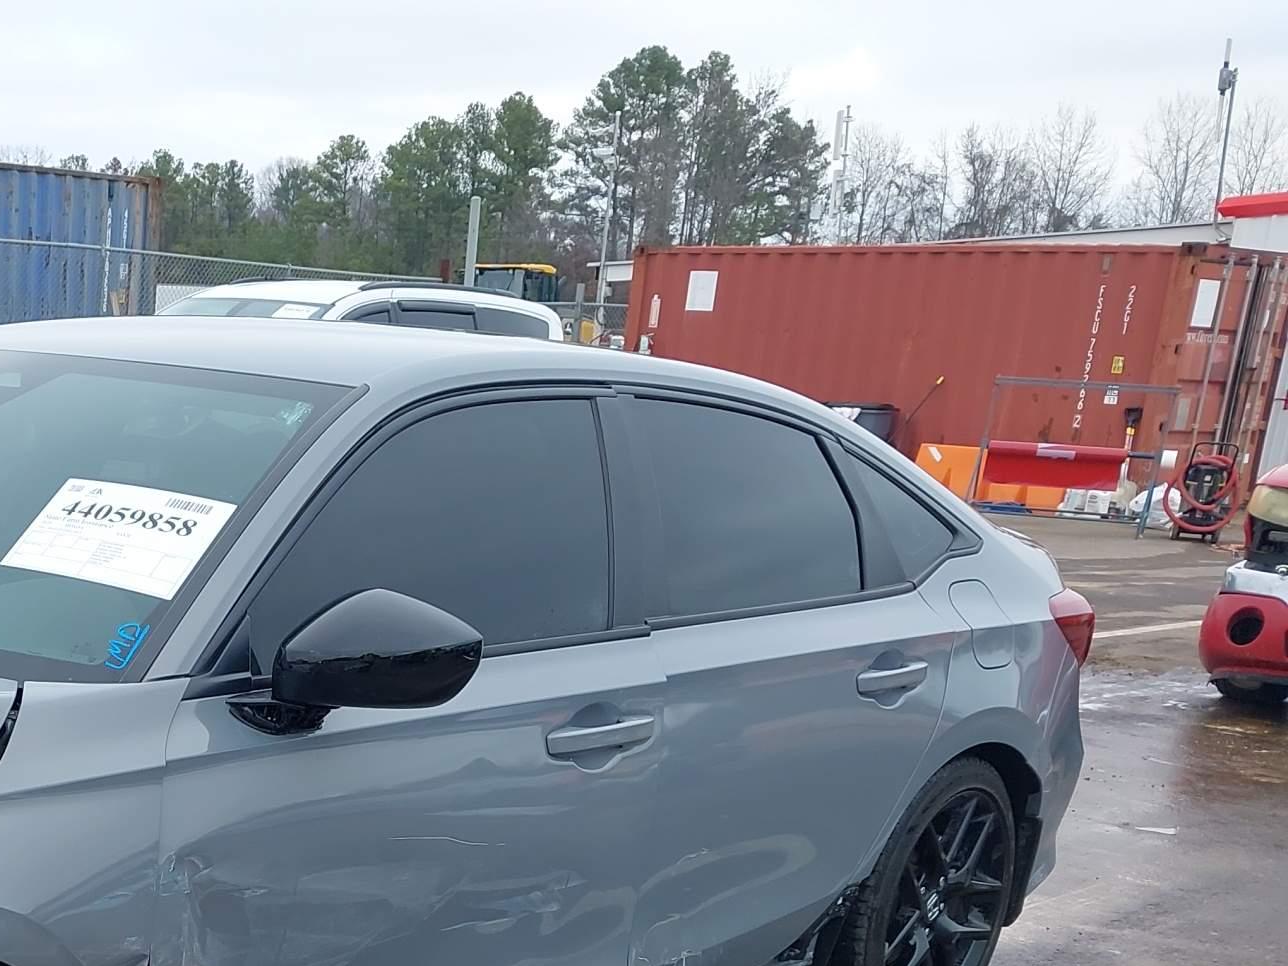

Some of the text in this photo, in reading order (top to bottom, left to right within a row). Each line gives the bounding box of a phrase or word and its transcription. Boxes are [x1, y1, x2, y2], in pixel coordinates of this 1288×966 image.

[1092, 285, 1106, 334] FSCU
[1122, 285, 1136, 335] 22G1
[61, 500, 197, 536] 44059858
